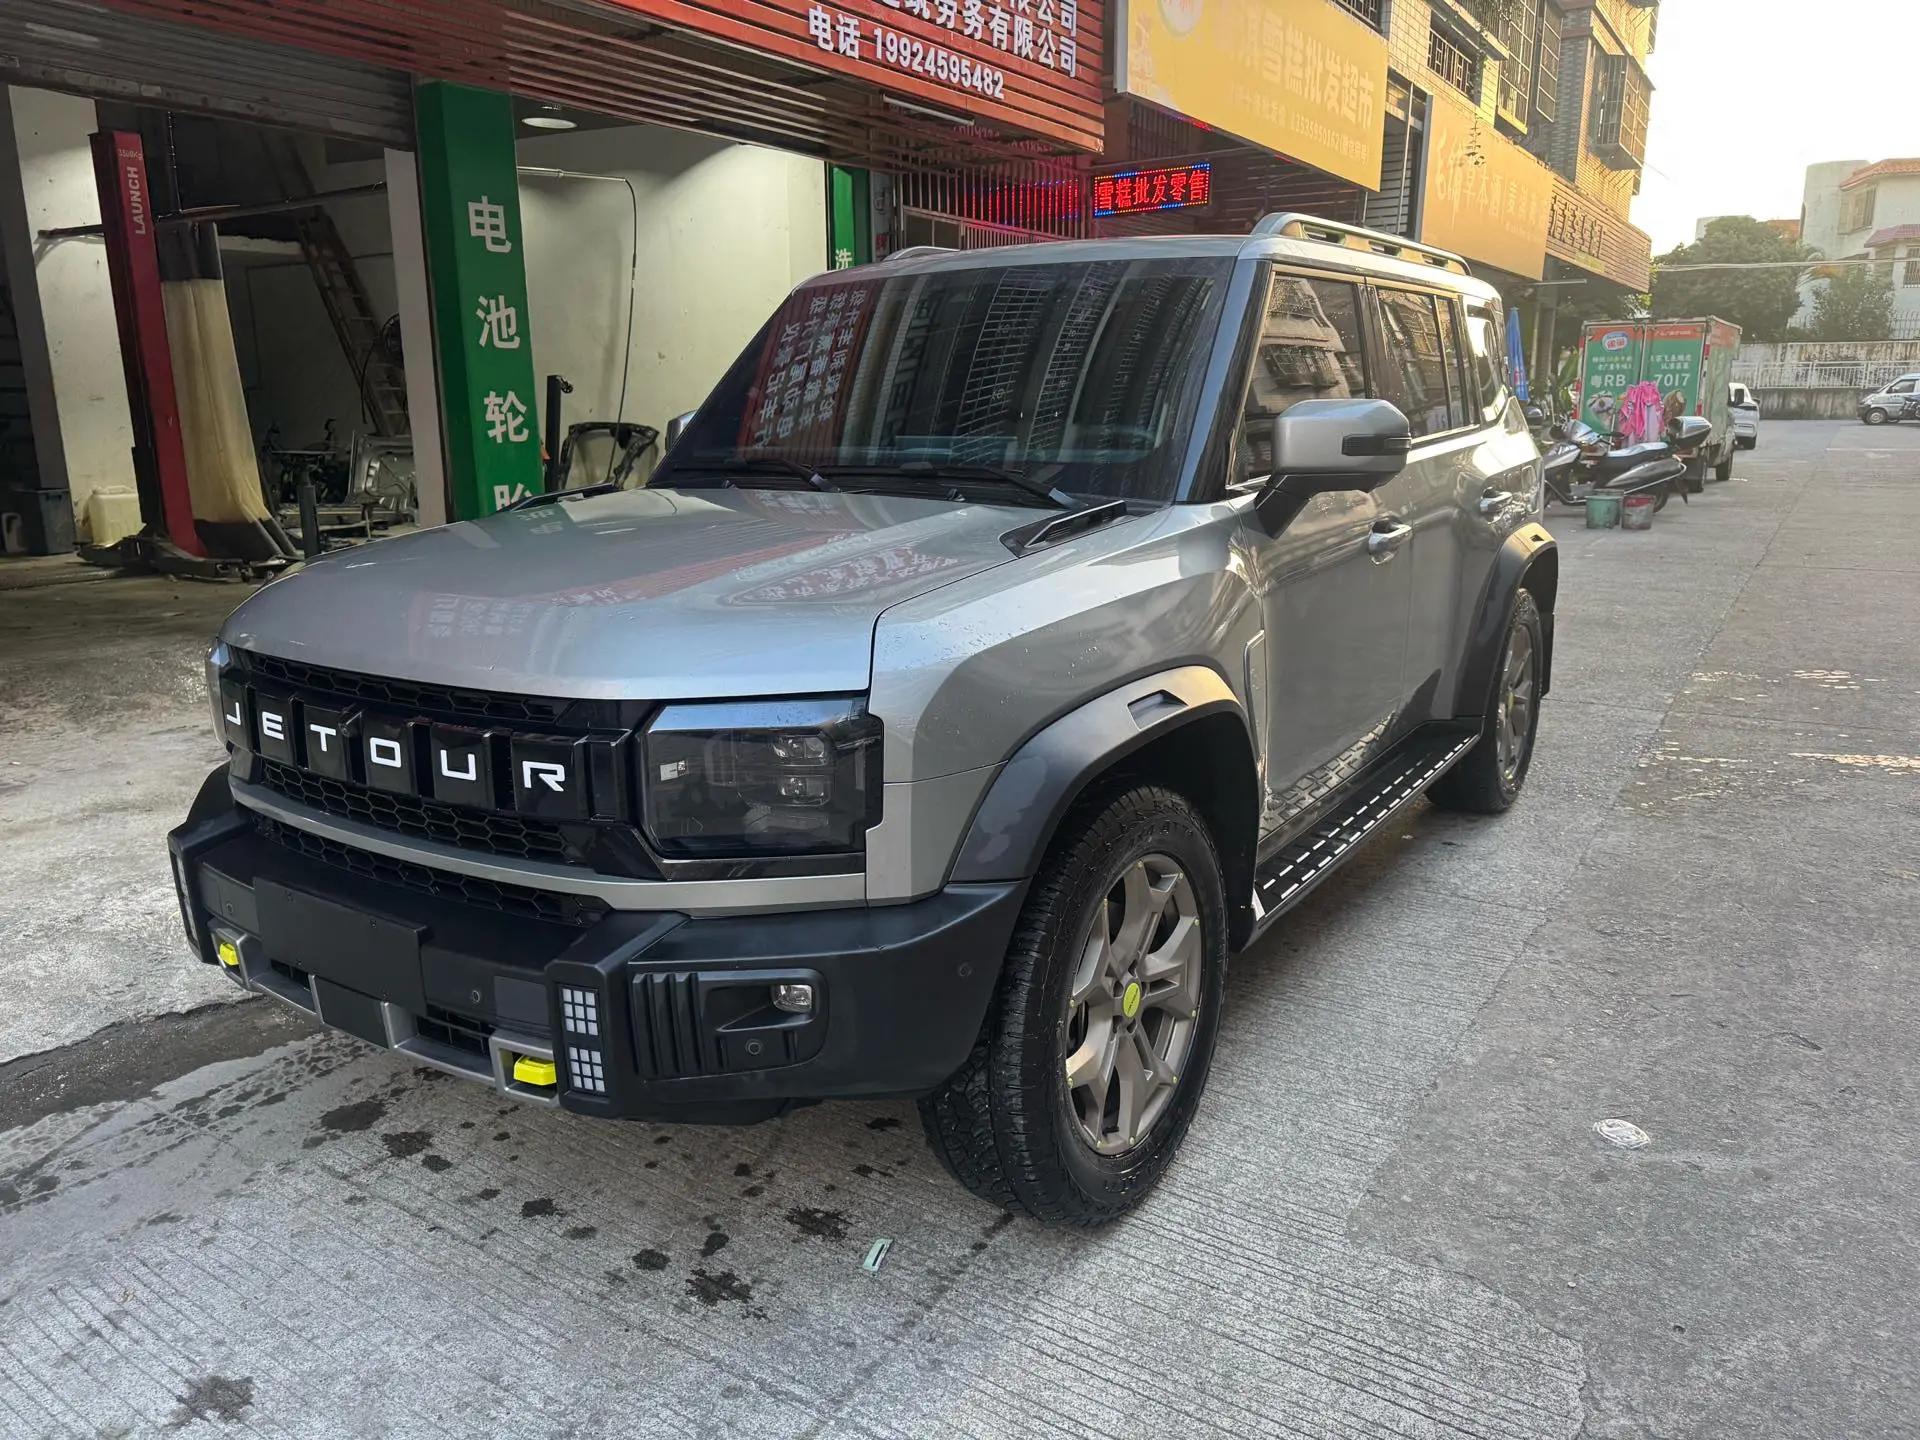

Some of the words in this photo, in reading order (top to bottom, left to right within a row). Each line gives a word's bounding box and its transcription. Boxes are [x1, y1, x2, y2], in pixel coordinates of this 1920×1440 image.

[809, 5, 861, 60] 电话
[873, 27, 1005, 100] 19924595482
[880, 0, 1077, 77] 劳务有限公司
[126, 166, 147, 236] LAUNCH
[1098, 170, 1206, 210] 雪糕批发零售
[1654, 373, 1691, 387] 7017
[225, 700, 567, 793] JETOUR
